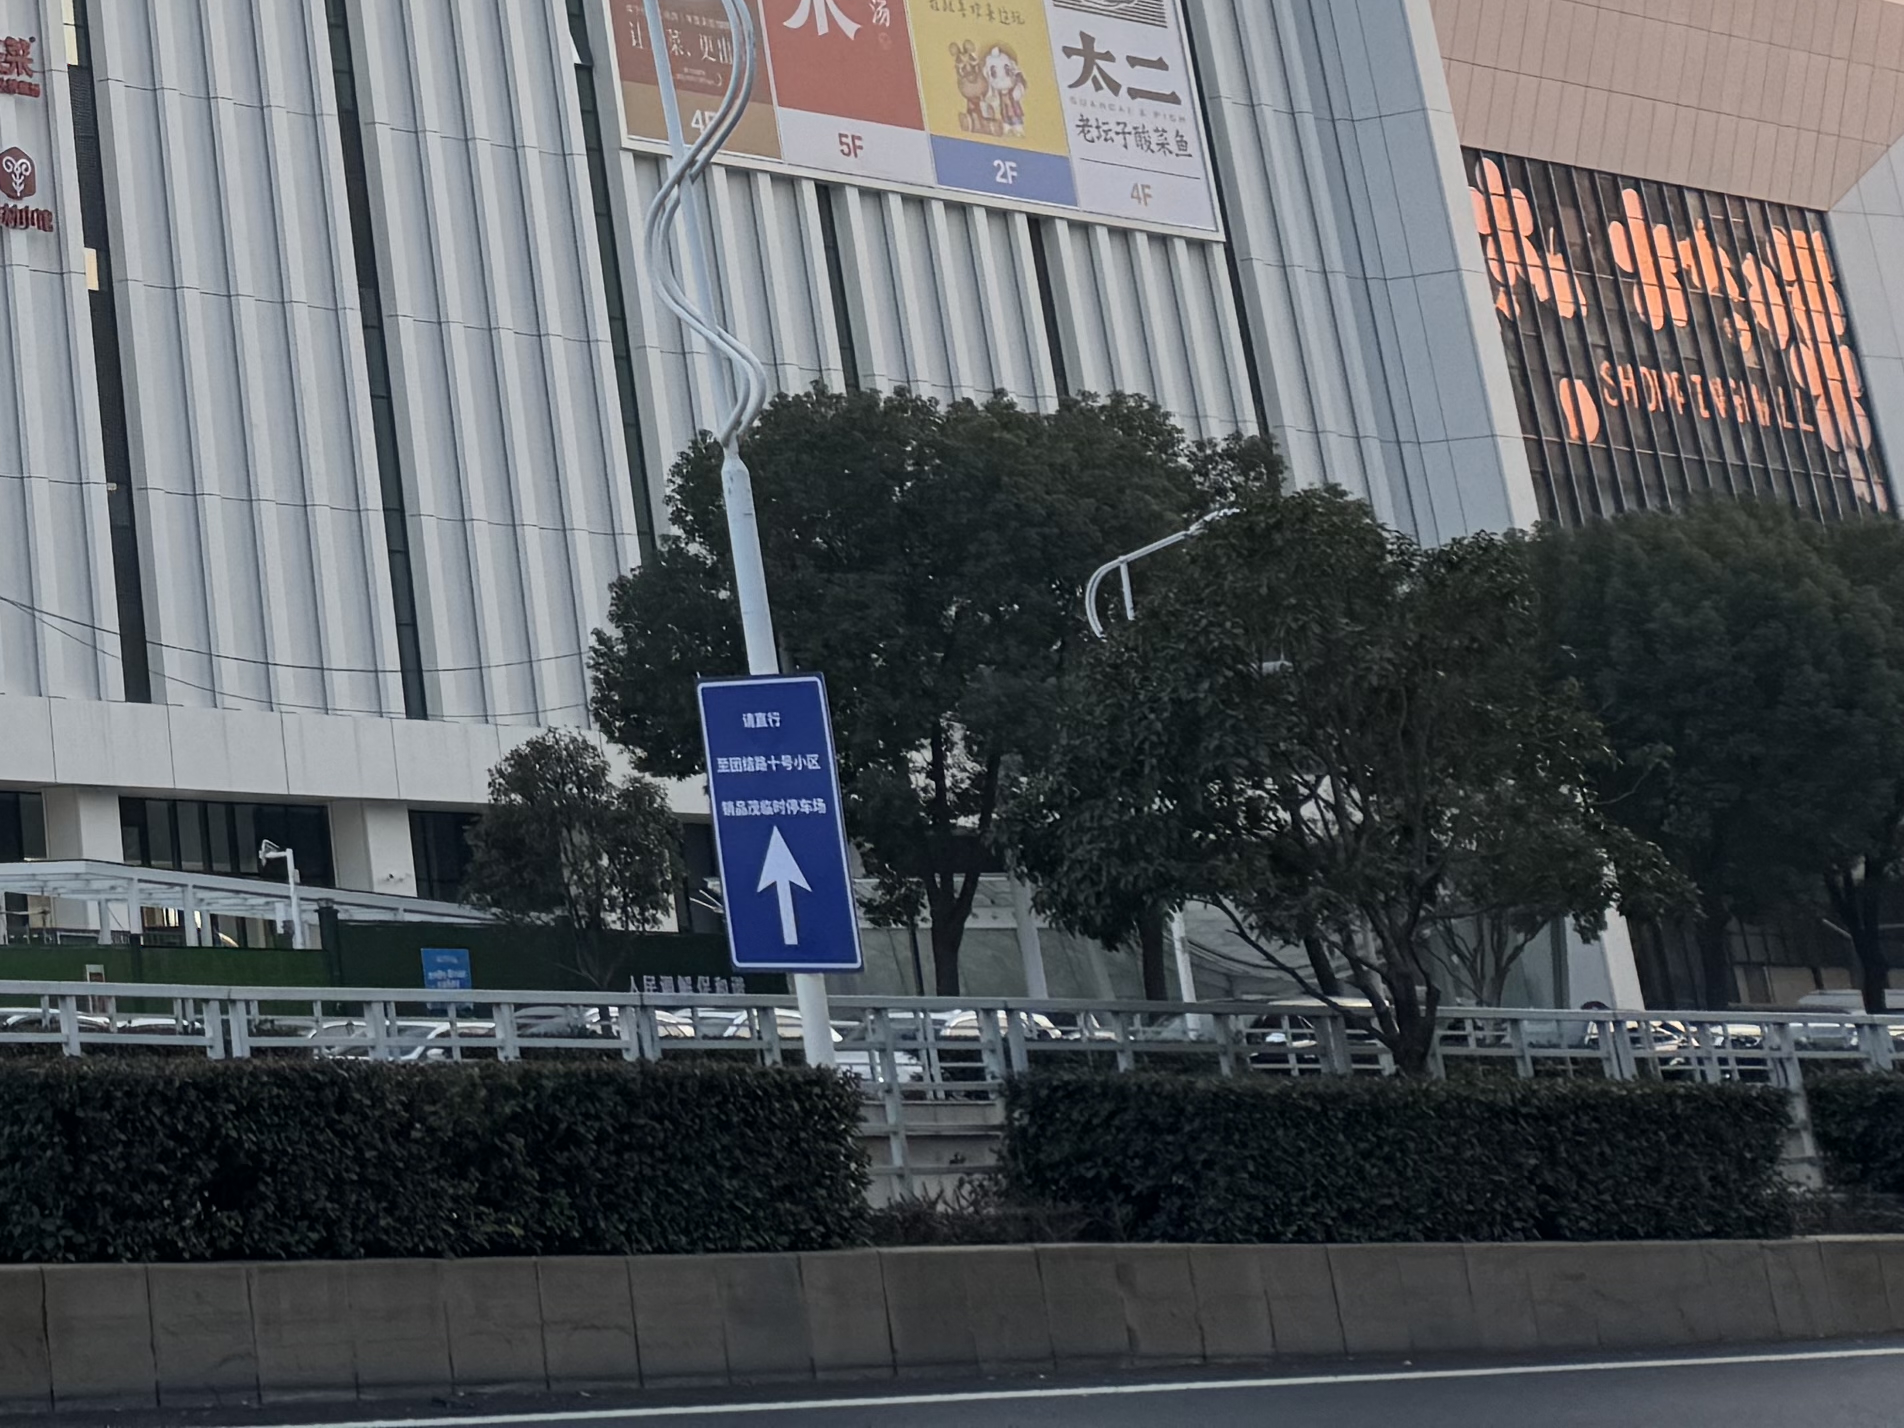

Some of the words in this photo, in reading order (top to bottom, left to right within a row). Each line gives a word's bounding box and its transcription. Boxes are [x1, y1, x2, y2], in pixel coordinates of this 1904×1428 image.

[1062, 30, 1182, 106] 太二
[839, 133, 864, 159] 5F
[1075, 112, 1193, 158] 老坛子酸菜鱼
[994, 159, 1018, 186] 2F
[1130, 182, 1152, 217] 4F
[742, 711, 781, 729] 请直行
[717, 753, 821, 773] 至团结路十号小区
[722, 799, 827, 817] 销品茂临时停车场
